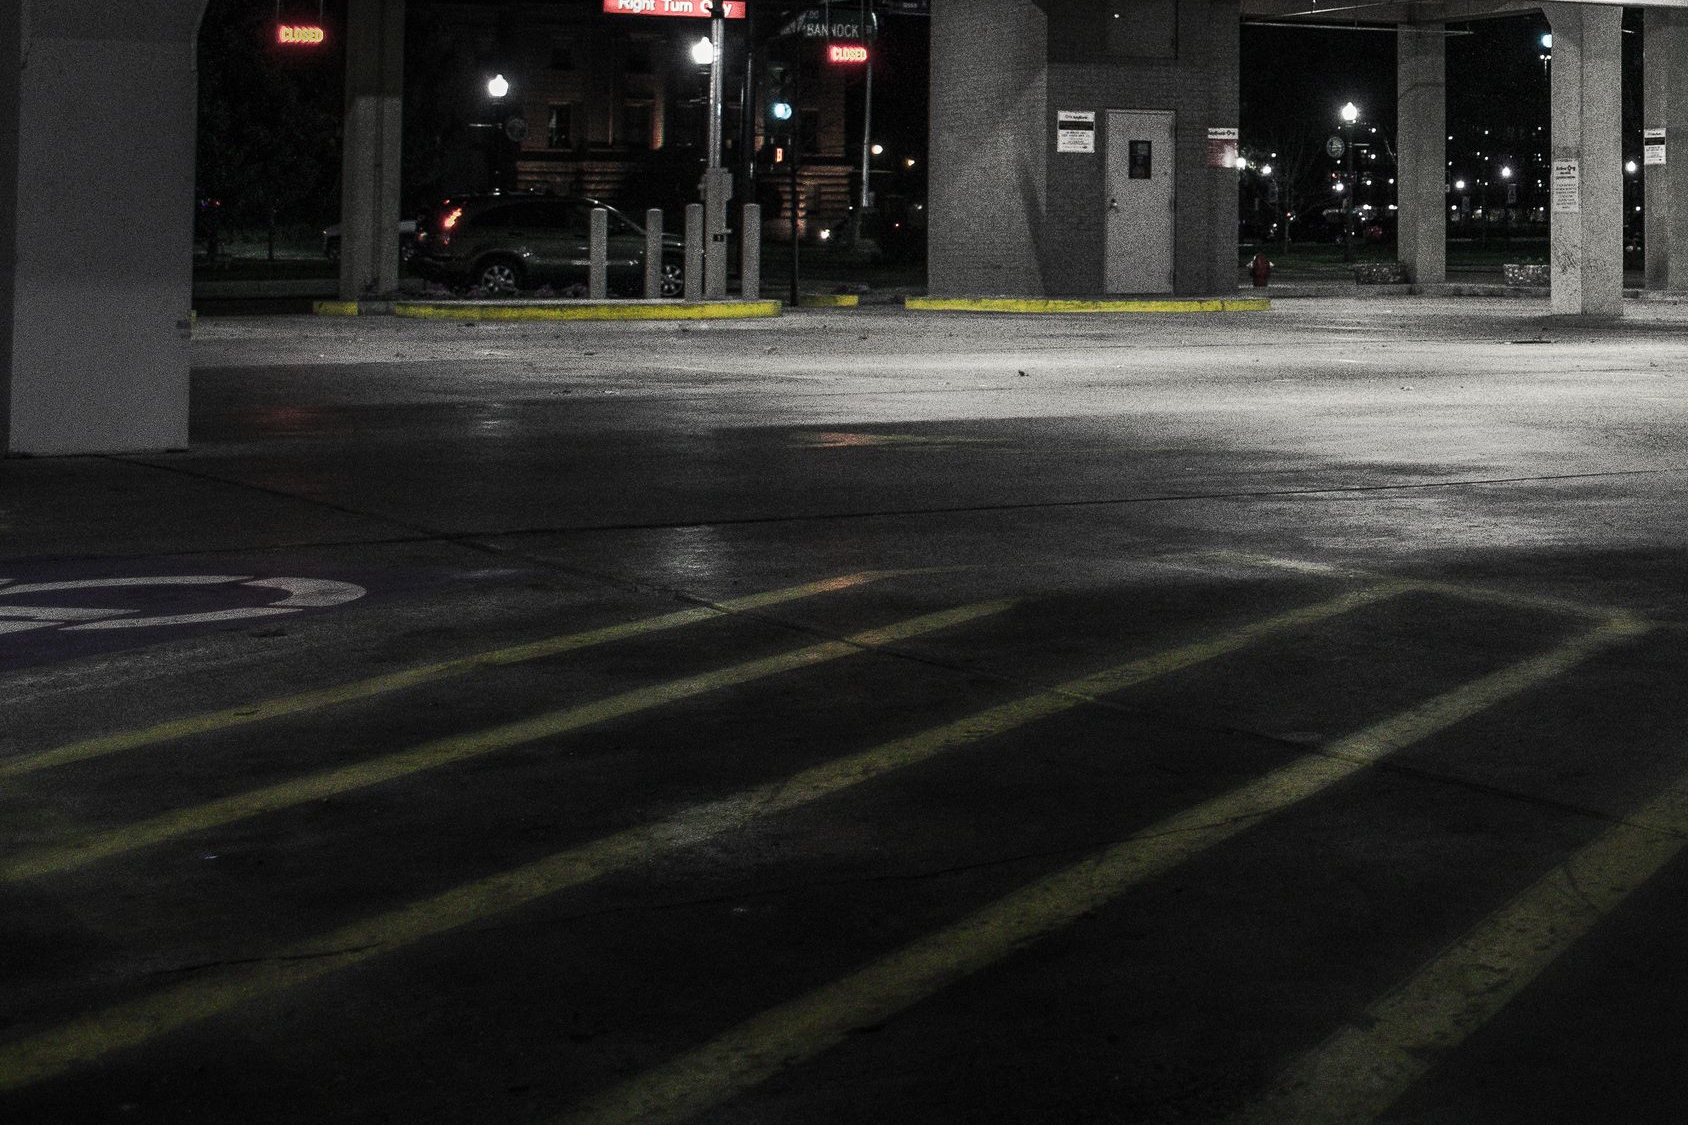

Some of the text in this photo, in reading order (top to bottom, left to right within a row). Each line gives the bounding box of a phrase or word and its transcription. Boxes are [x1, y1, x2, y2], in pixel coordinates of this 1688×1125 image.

[700, 0, 733, 17] Oy
[279, 25, 324, 43] CLOSED
[806, 22, 860, 38] BANNOCK
[831, 46, 867, 62] CLOSED
